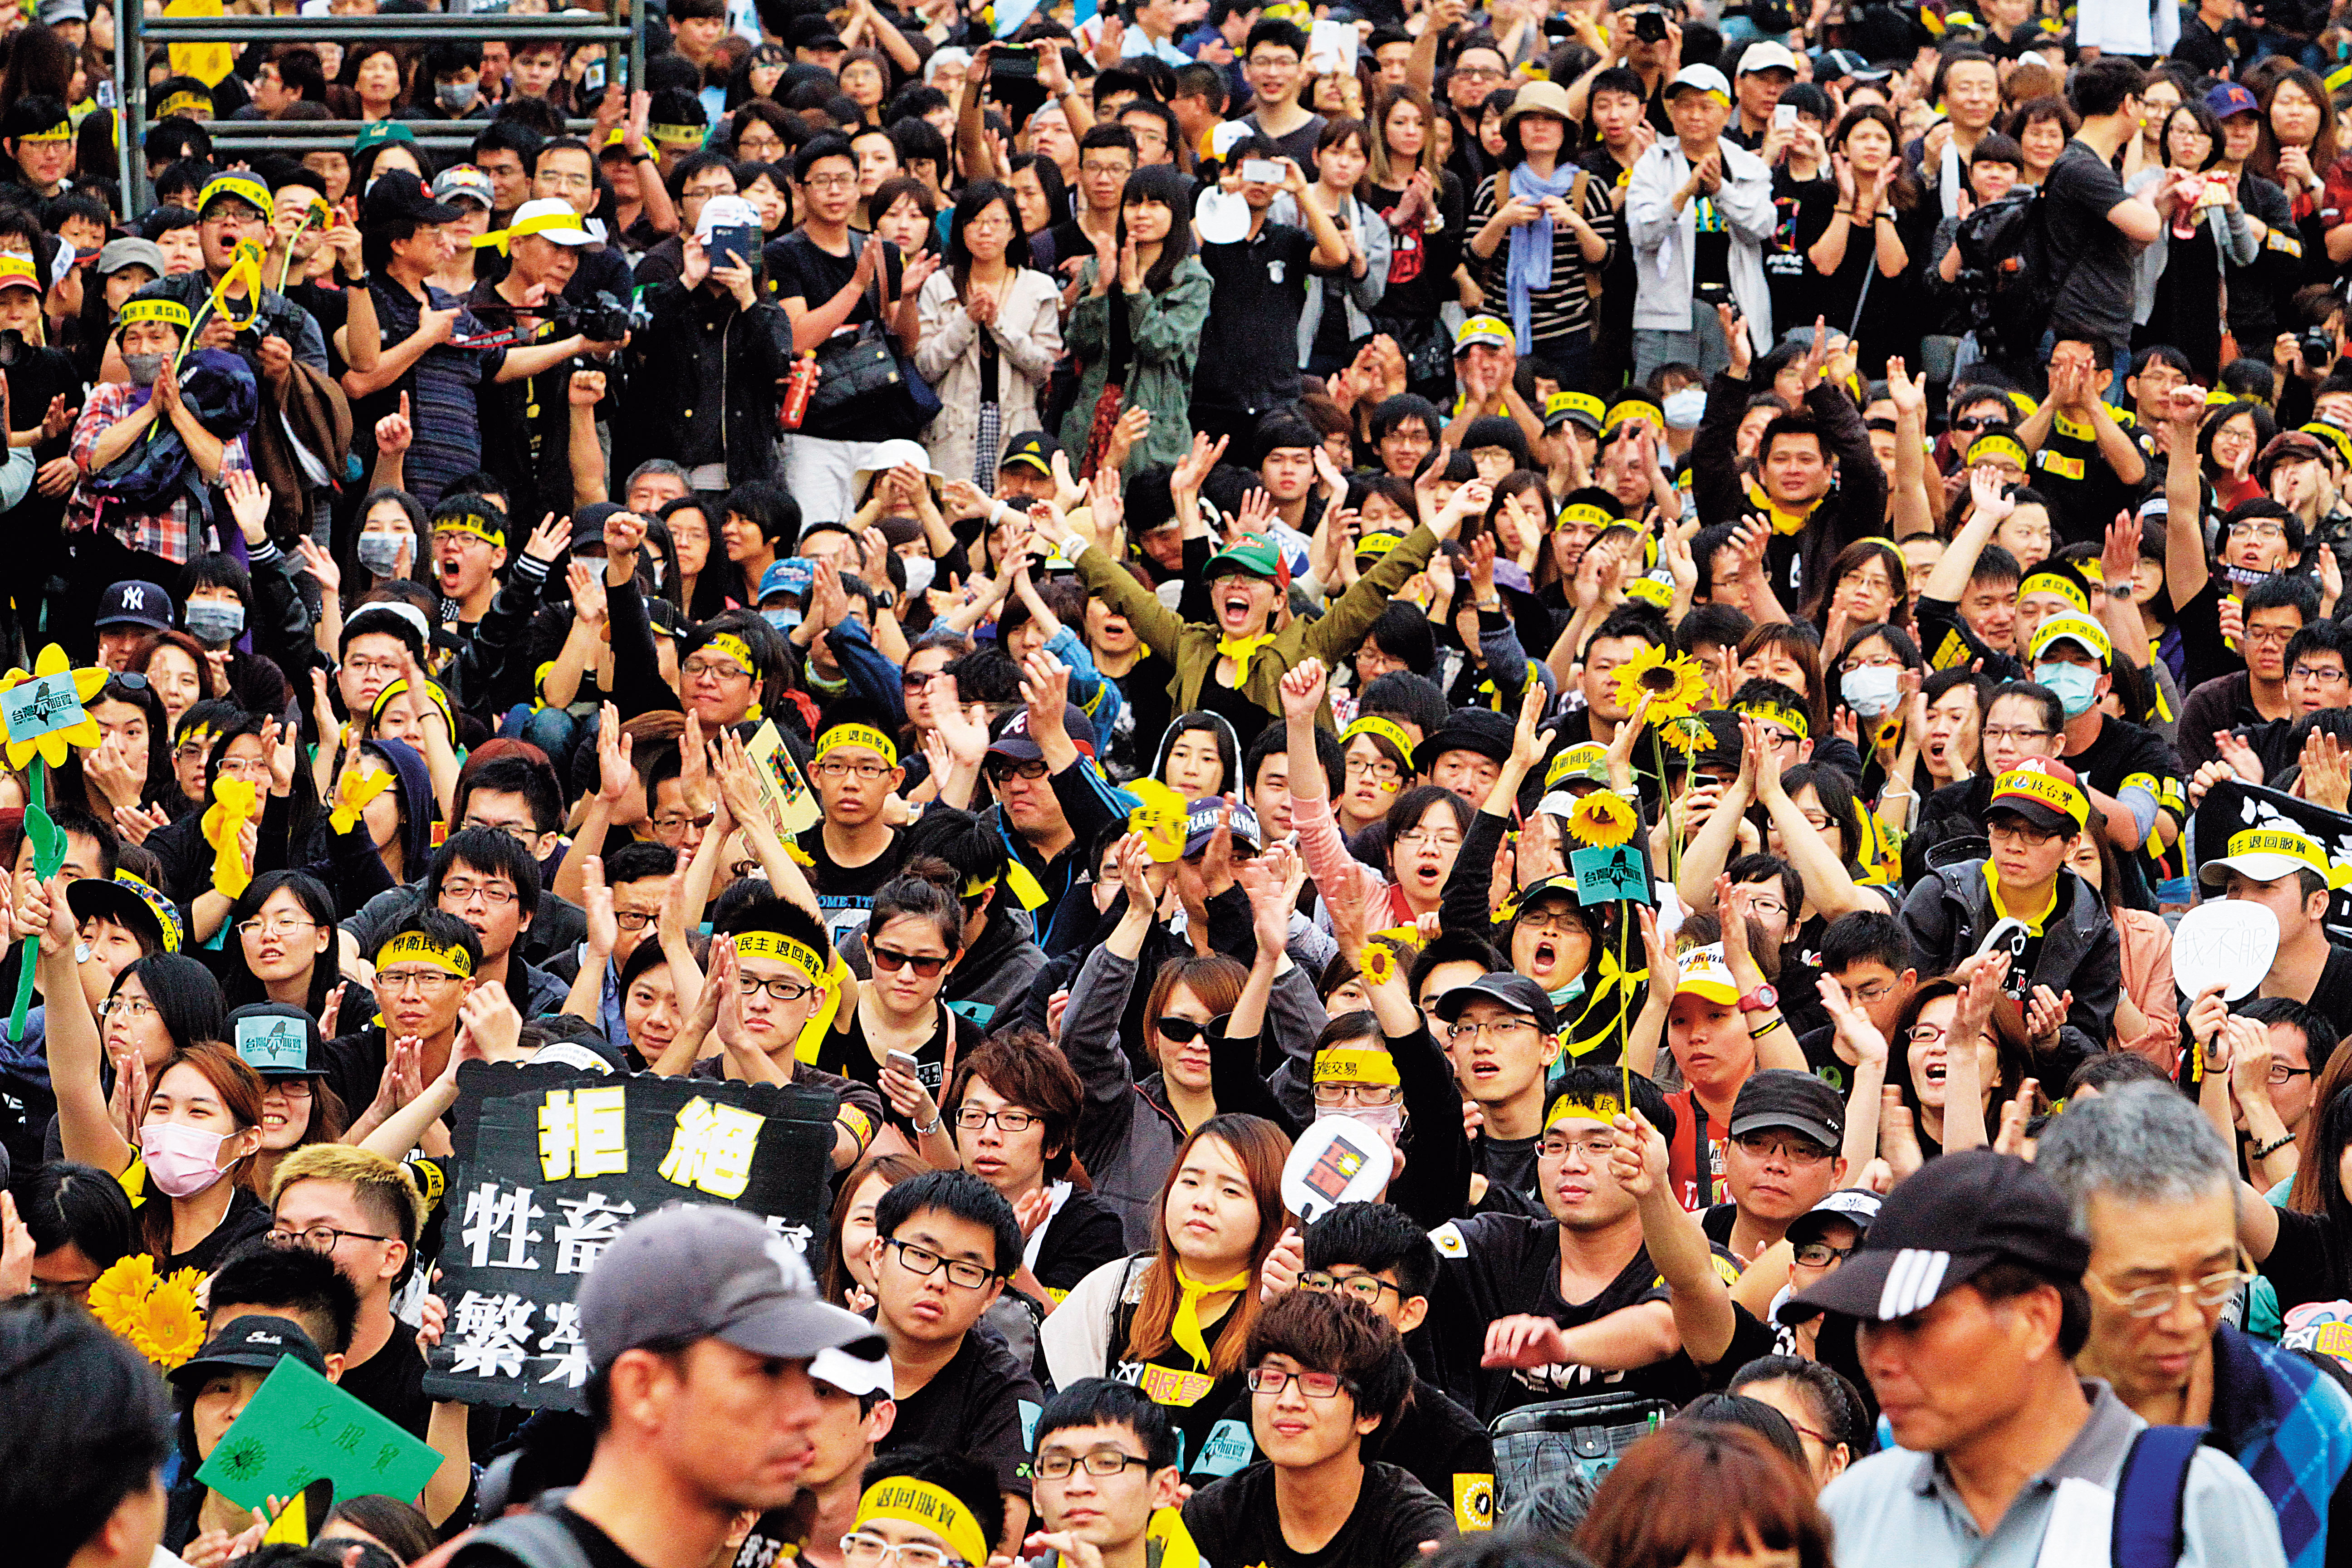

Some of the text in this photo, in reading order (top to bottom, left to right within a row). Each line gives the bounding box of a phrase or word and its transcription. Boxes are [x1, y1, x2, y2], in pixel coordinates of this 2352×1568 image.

[2030, 779, 2072, 807] 救台灣
[2249, 835, 2306, 855] 退回服貿
[735, 936, 822, 978] 民主 退回服貿
[538, 1085, 765, 1199] 拒絕
[300, 1404, 401, 1475] 反服貿
[875, 1486, 957, 1529] 退回服貿
